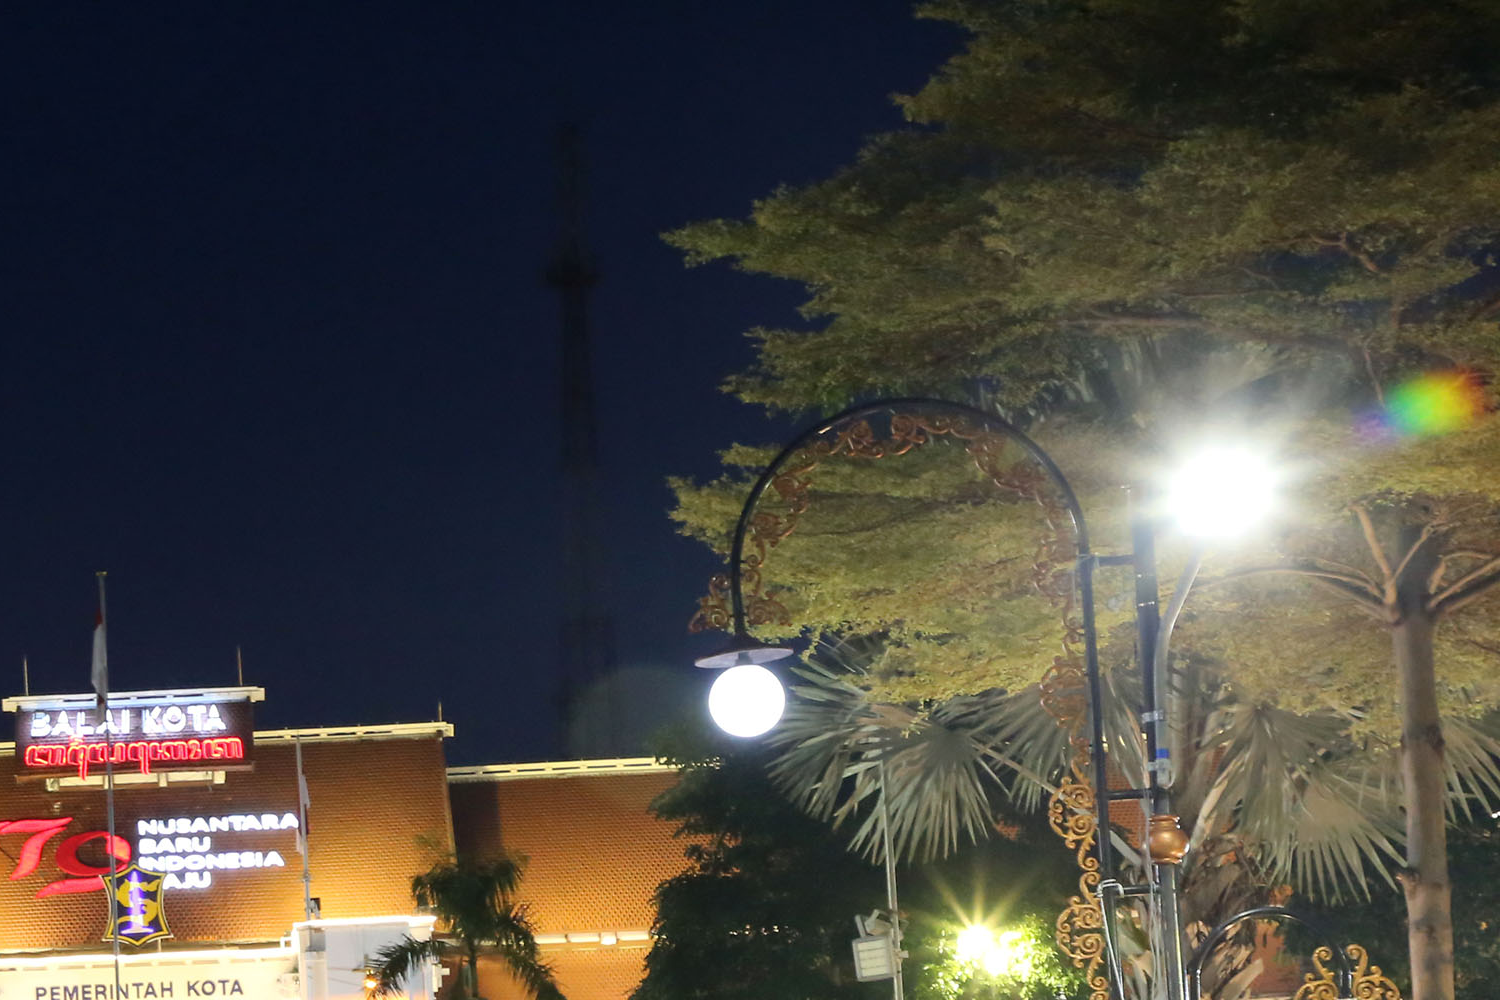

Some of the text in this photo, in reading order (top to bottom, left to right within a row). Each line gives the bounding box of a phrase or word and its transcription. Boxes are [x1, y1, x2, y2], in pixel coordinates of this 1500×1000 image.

[31, 704, 227, 737] BALAI KOTA
[137, 813, 299, 835] NUSANTARA
[138, 836, 211, 854] BARU
[138, 851, 285, 871] INDONESIA
[163, 871, 212, 890] AJU
[186, 979, 244, 998] KOTA
